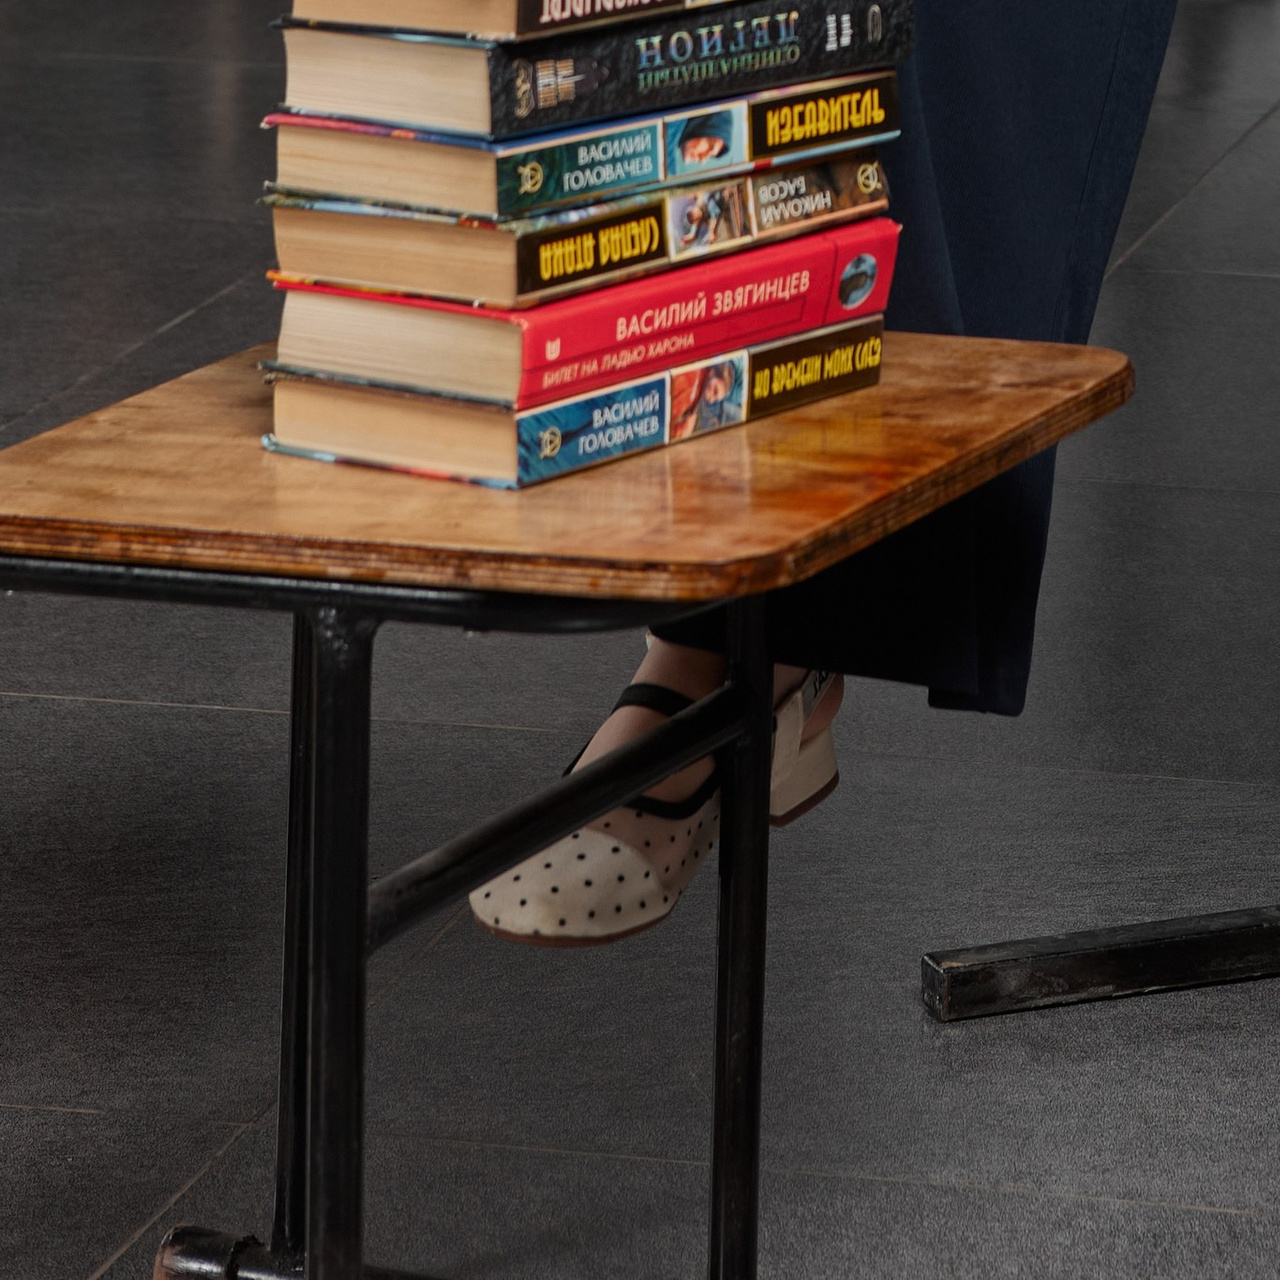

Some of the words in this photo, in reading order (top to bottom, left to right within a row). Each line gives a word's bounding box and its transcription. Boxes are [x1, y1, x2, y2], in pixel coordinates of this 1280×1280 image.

[635, 10, 799, 71] ЛЕГИОН
[766, 88, 886, 147] ИЗБАВИТЕЛЬ
[577, 131, 653, 164] ВАСИЛИЙ
[563, 155, 654, 192] ГОЛОВАЧЕВ
[758, 175, 807, 203] БАСОВ
[761, 188, 832, 225] НИКОЛАЙ
[539, 232, 598, 282] АТАКА
[599, 215, 660, 273] СЛЕПАЯ
[616, 292, 707, 342] ВАСИЛИЙ
[711, 270, 811, 316] ЗВЯГИНЦЕВ
[542, 362, 581, 390] БИЛЕТ
[581, 359, 600, 378] НА
[601, 345, 647, 372] ЛАДЬЮ
[648, 332, 696, 358] ХАРОНА
[823, 344, 855, 380] МОИХ
[592, 388, 661, 428] ВАСИЛИЙ
[578, 414, 661, 455] ГОЛОВАЧЕВ
